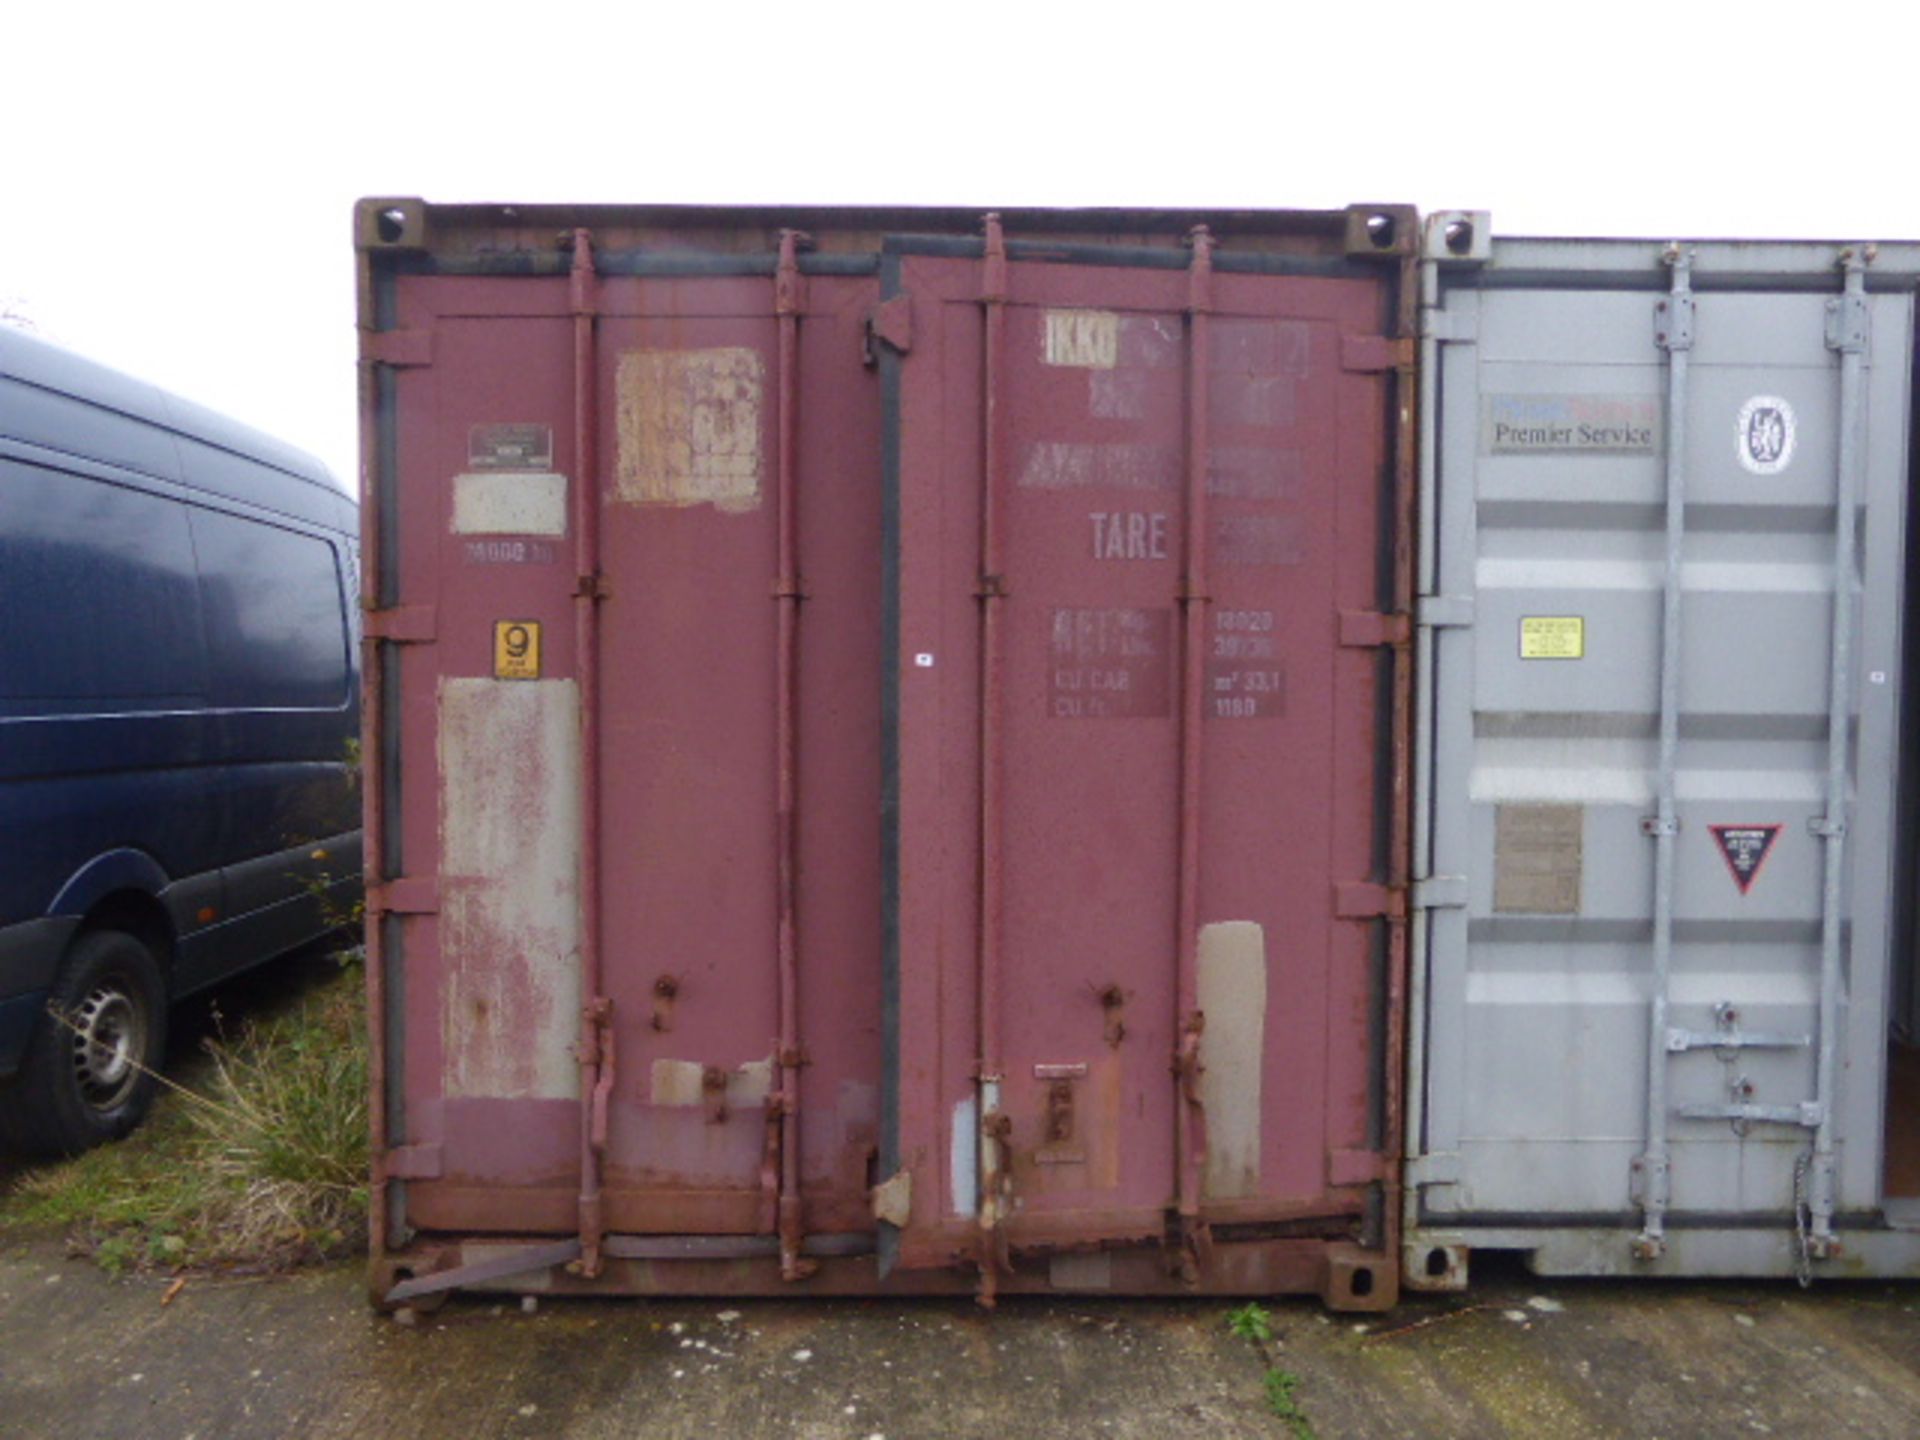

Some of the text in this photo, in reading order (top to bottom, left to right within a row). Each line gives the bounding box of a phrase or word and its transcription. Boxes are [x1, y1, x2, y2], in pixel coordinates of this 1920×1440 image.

[1494, 421, 1652, 444] Premier Service
[1089, 513, 1168, 560] TARE
[504, 625, 529, 658] 9
